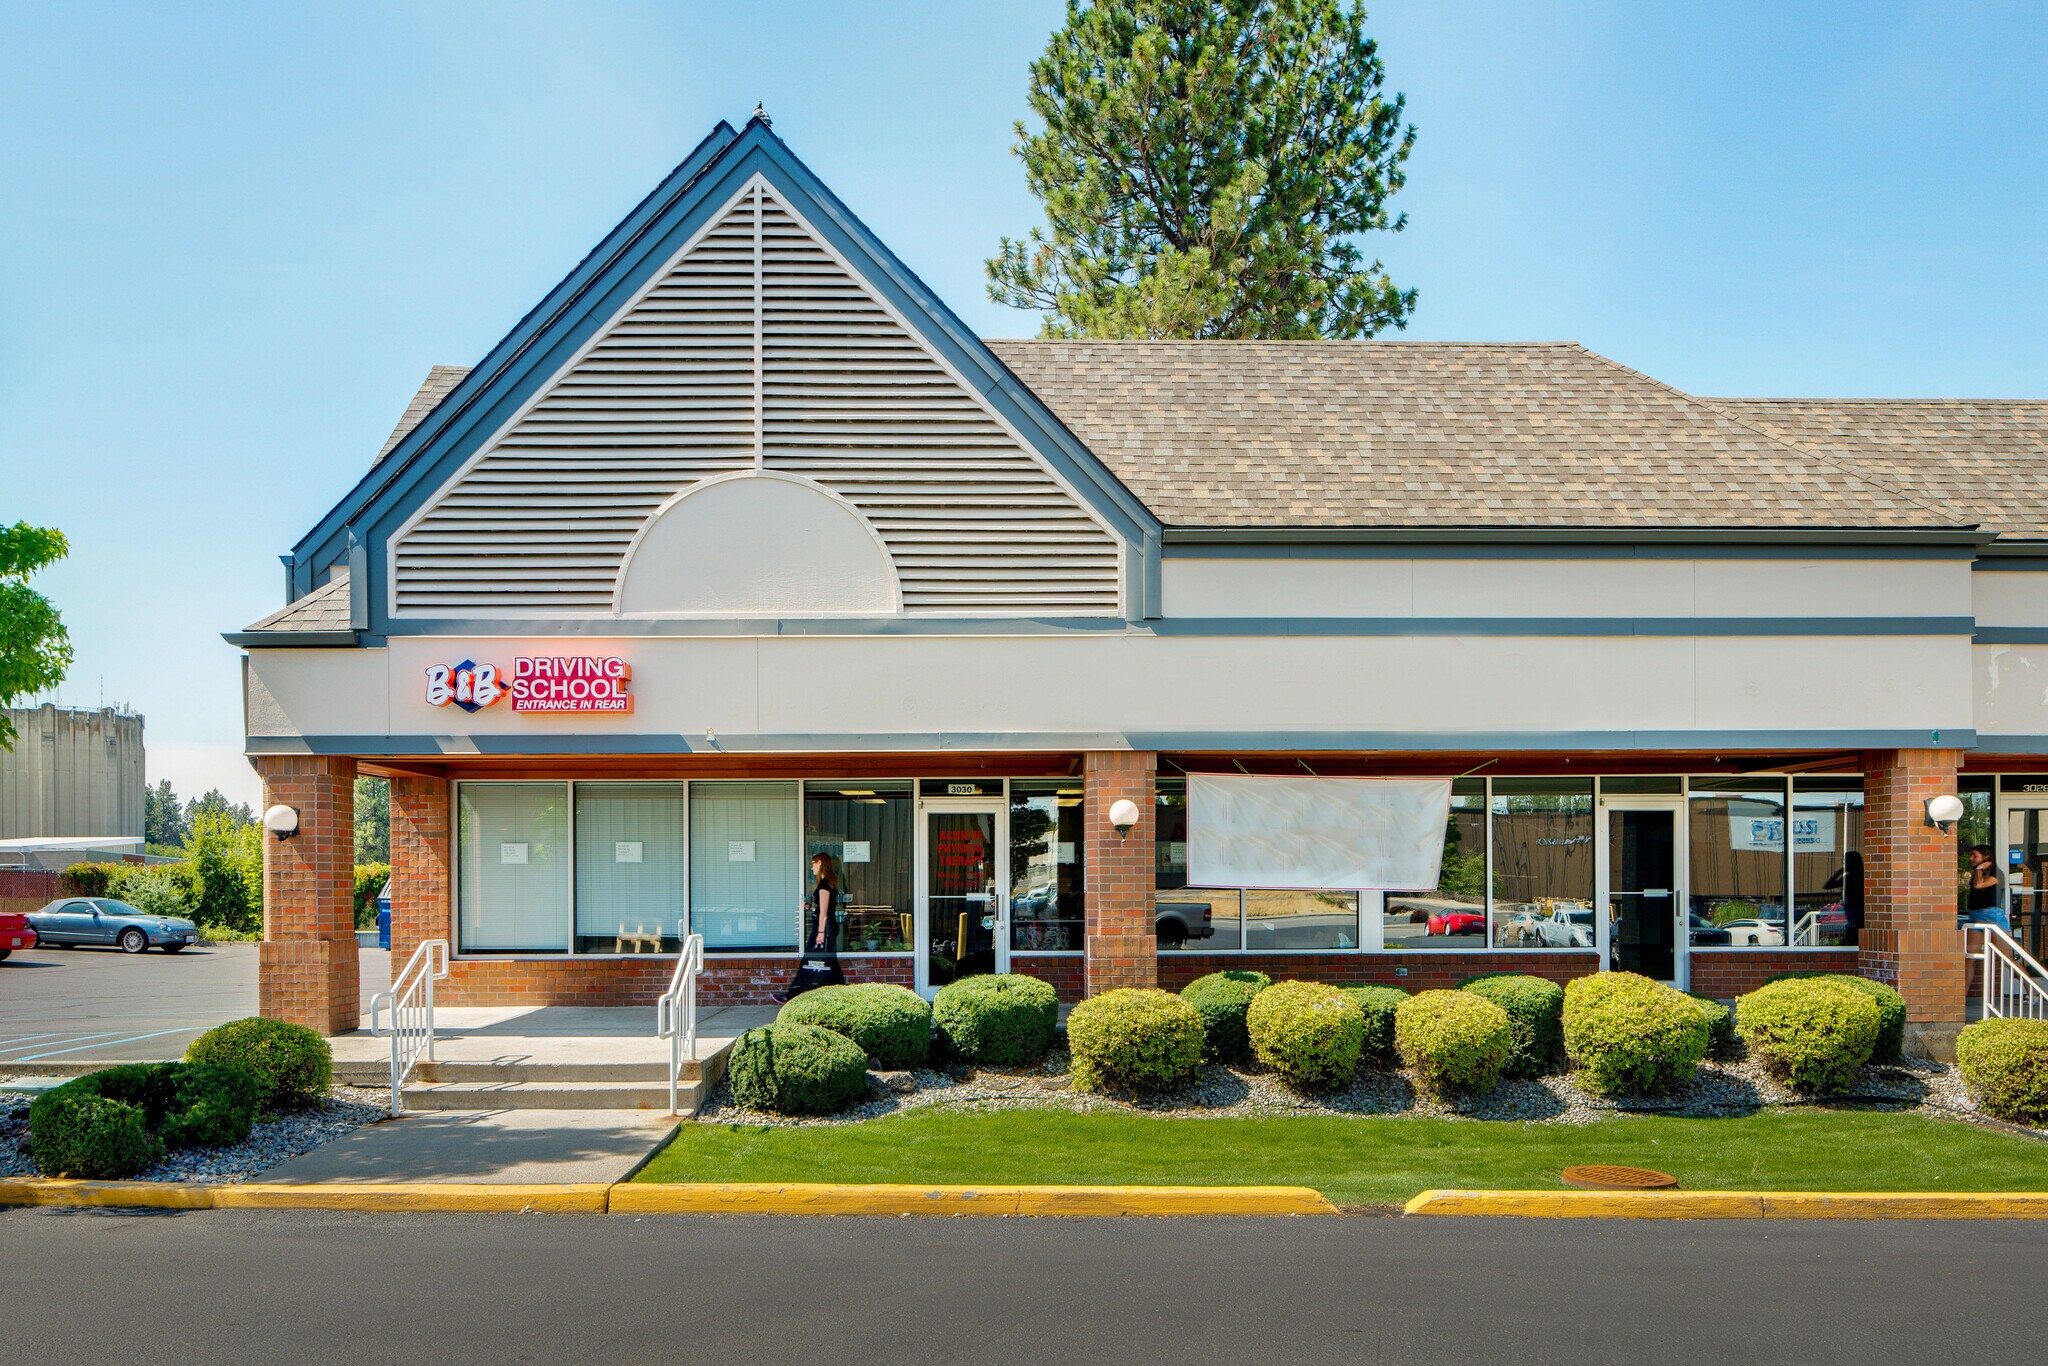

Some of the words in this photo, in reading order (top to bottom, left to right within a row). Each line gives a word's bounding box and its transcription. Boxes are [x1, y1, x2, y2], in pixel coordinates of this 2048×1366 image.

[515, 657, 625, 677] DRIVING
[425, 664, 501, 706] B&B
[512, 679, 627, 699] SCHOOL
[516, 700, 577, 710] ENTRANCE
[579, 700, 593, 710] IN
[594, 700, 626, 710] REAR
[940, 830, 983, 841] ACHIEVE
[937, 843, 984, 854] PHYSICAL
[940, 856, 983, 866] THERAPY
